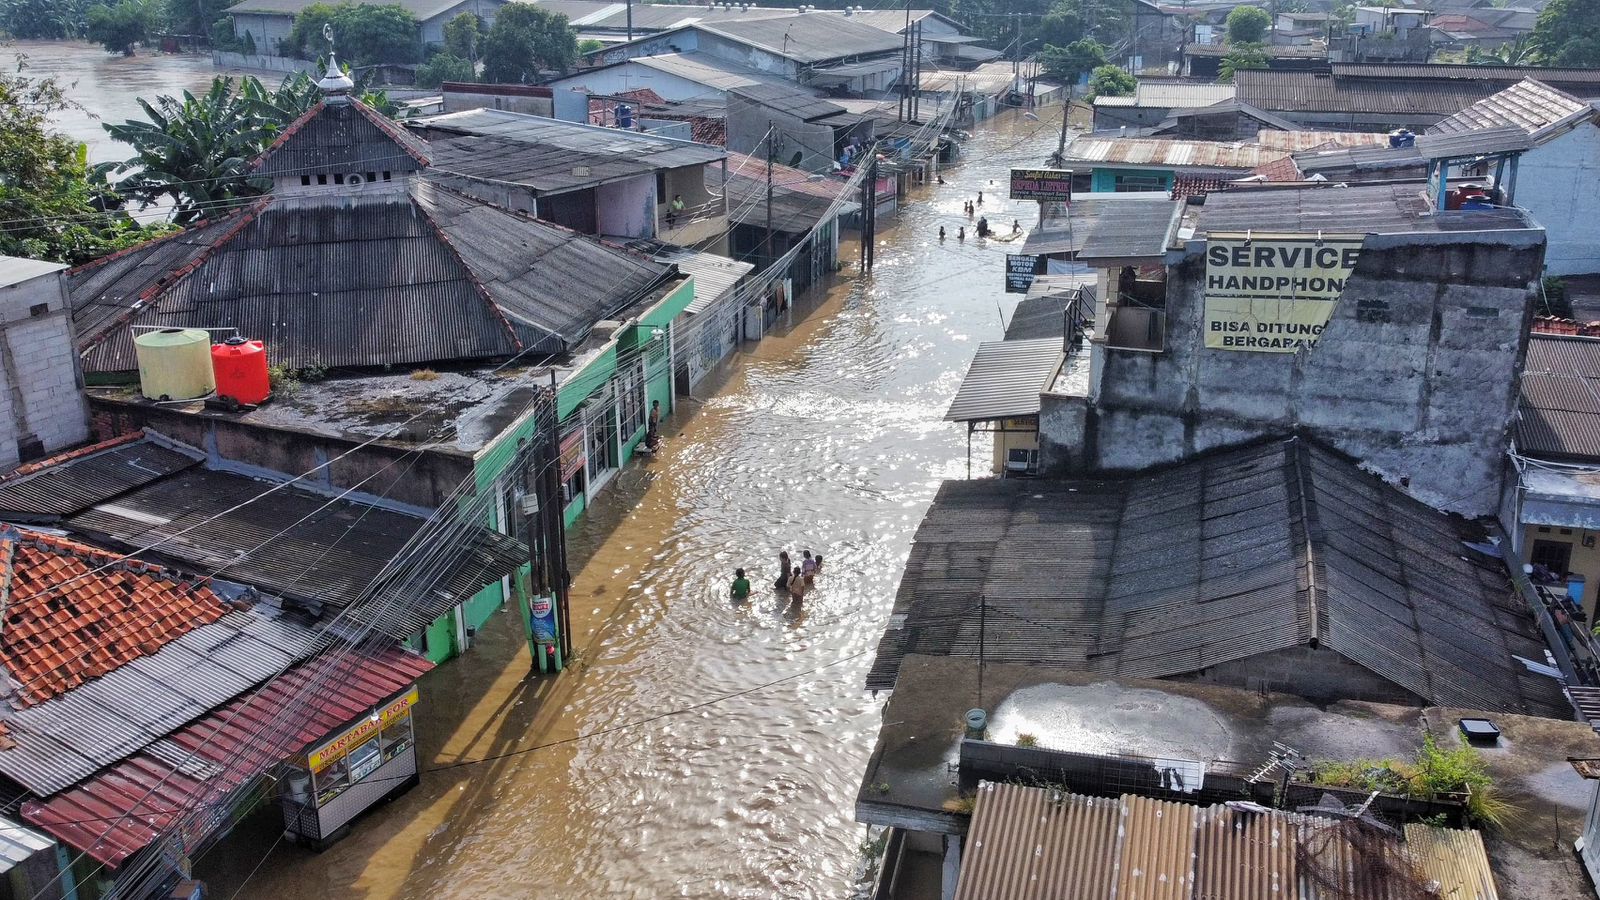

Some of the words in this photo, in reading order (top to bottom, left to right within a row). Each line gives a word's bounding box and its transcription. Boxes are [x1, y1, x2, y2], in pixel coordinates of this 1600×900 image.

[1012, 180, 1040, 191] SEPEDA
[1208, 246, 1360, 269] SERVICE
[1208, 275, 1349, 293] HANDPHON
[1211, 321, 1250, 332] BISA
[1257, 320, 1329, 335] DITUNG
